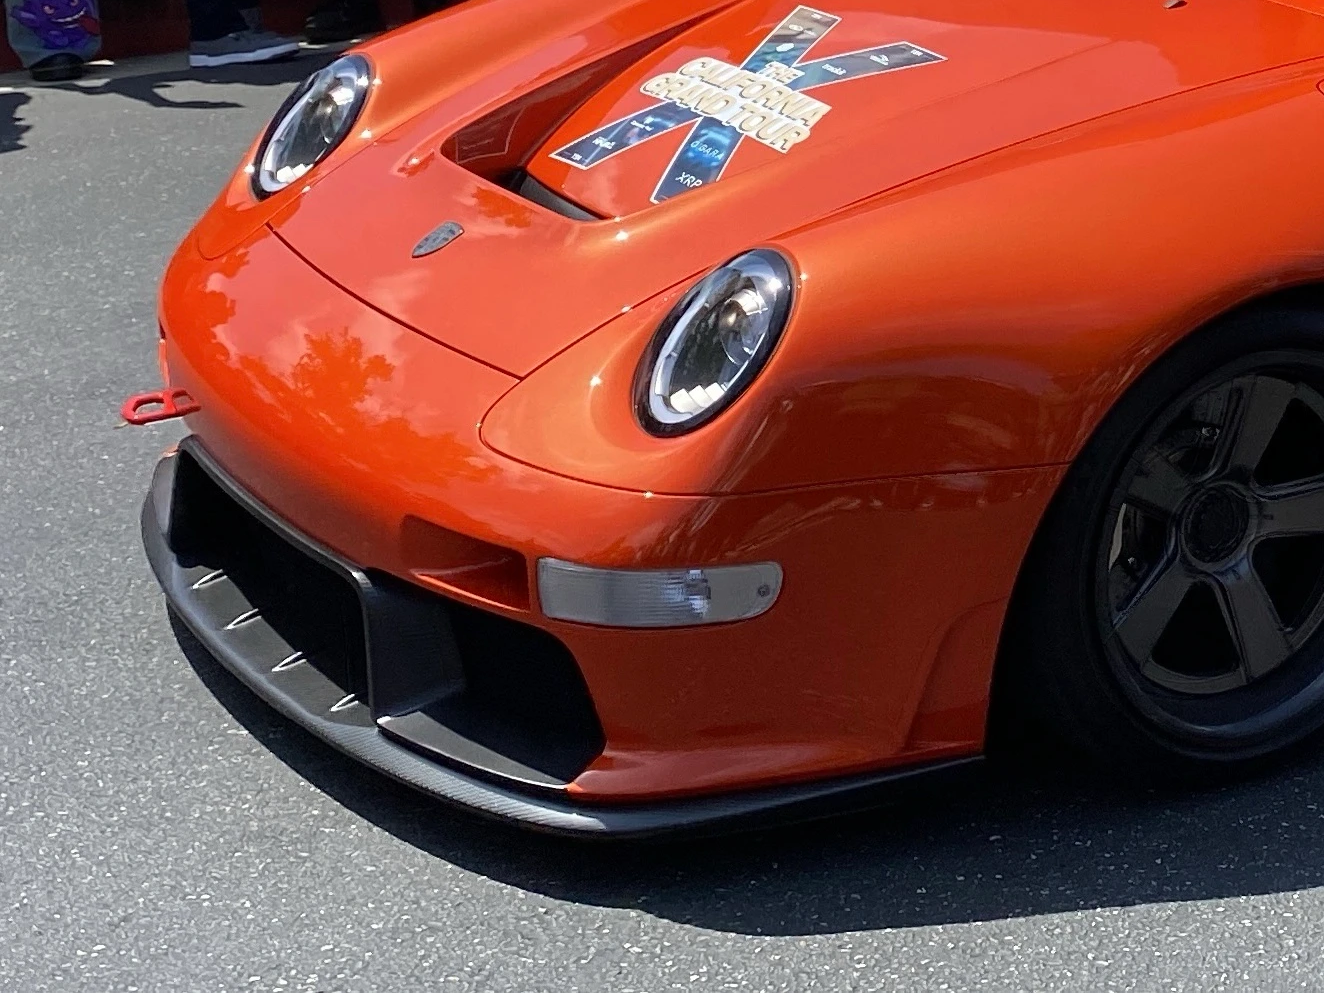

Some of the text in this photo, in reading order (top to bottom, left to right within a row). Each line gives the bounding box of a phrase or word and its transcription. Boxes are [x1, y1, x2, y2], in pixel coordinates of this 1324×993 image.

[679, 59, 825, 127] CALIFORNIA
[765, 63, 799, 84] THE
[643, 75, 736, 115] GRAND
[727, 103, 805, 151] TOUR
[675, 171, 703, 188] XRP
